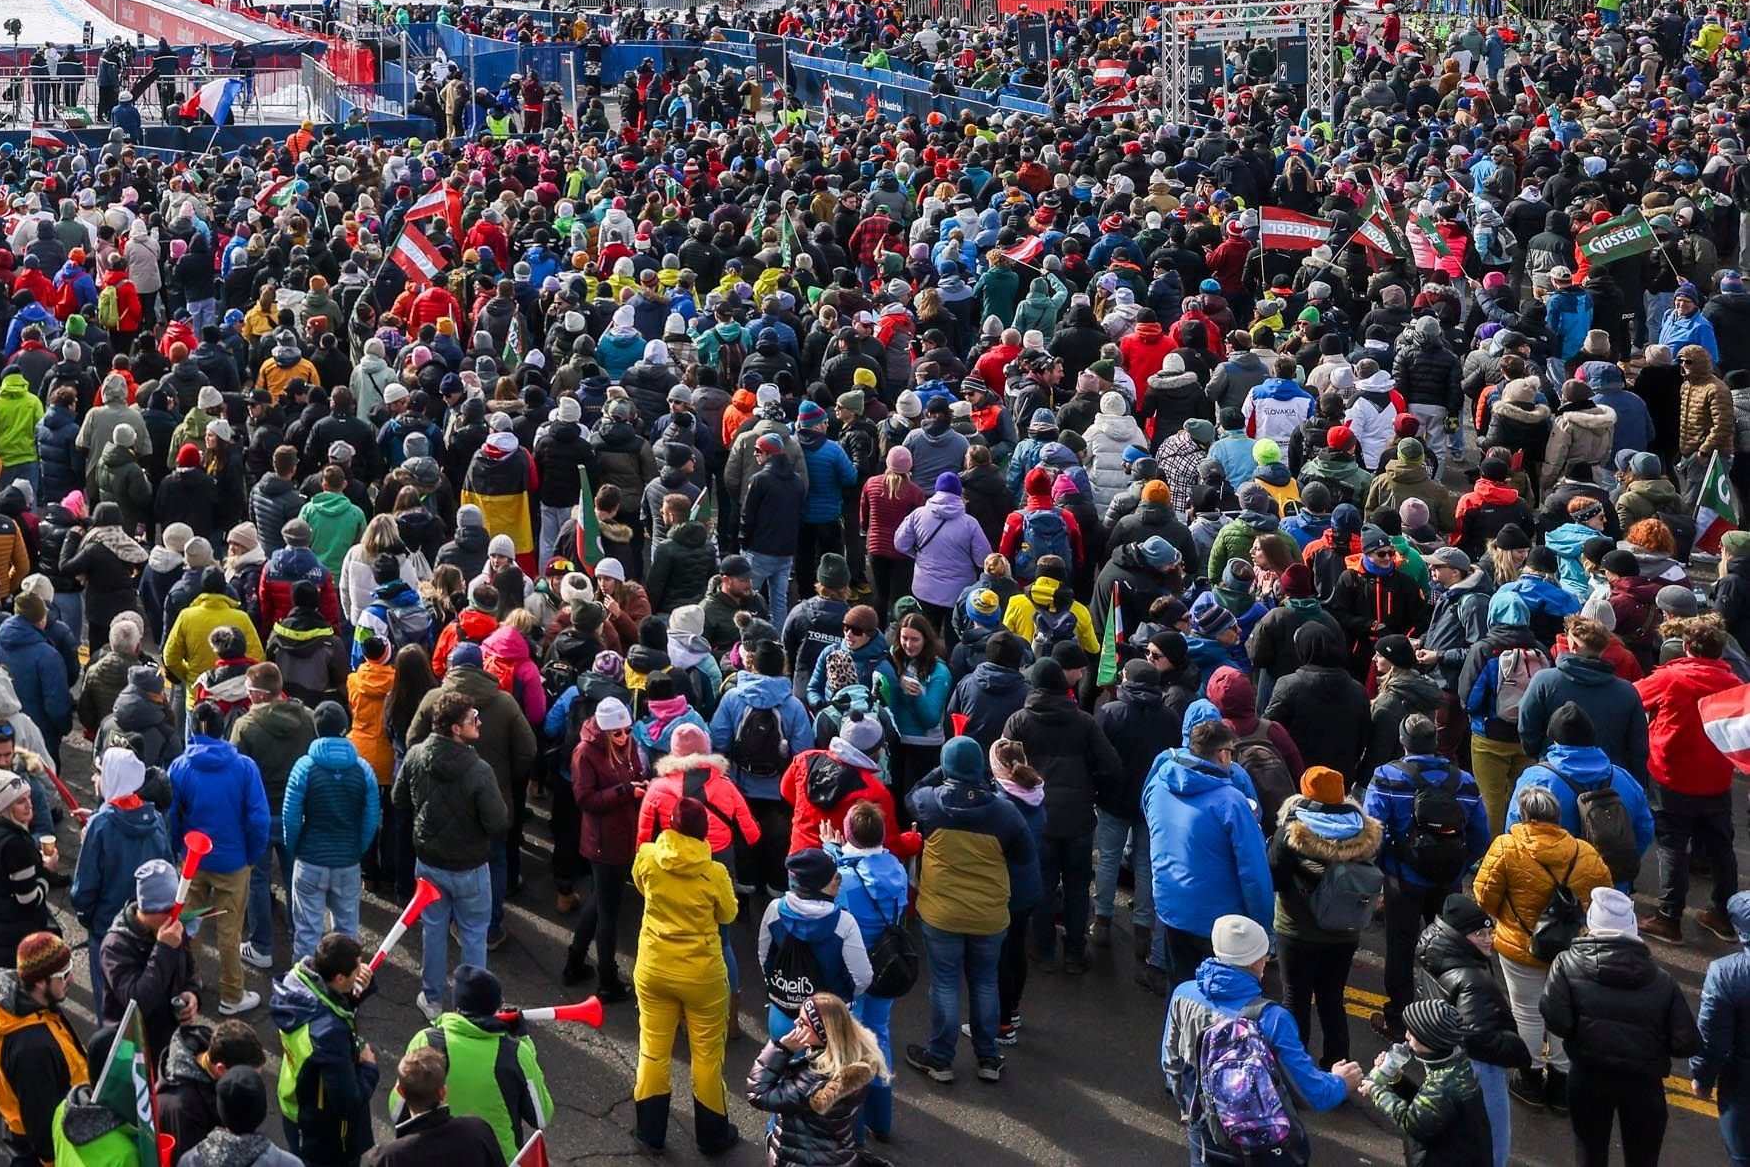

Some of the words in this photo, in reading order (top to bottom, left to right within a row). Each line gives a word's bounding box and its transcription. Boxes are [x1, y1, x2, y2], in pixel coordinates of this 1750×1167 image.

[1030, 42, 1036, 57] 4
[1190, 66, 1203, 83] 45
[1280, 63, 1286, 79] 2
[884, 101, 901, 112] Austria
[1588, 225, 1644, 255] Gösser
[1264, 408, 1296, 416] SLOVAKIA
